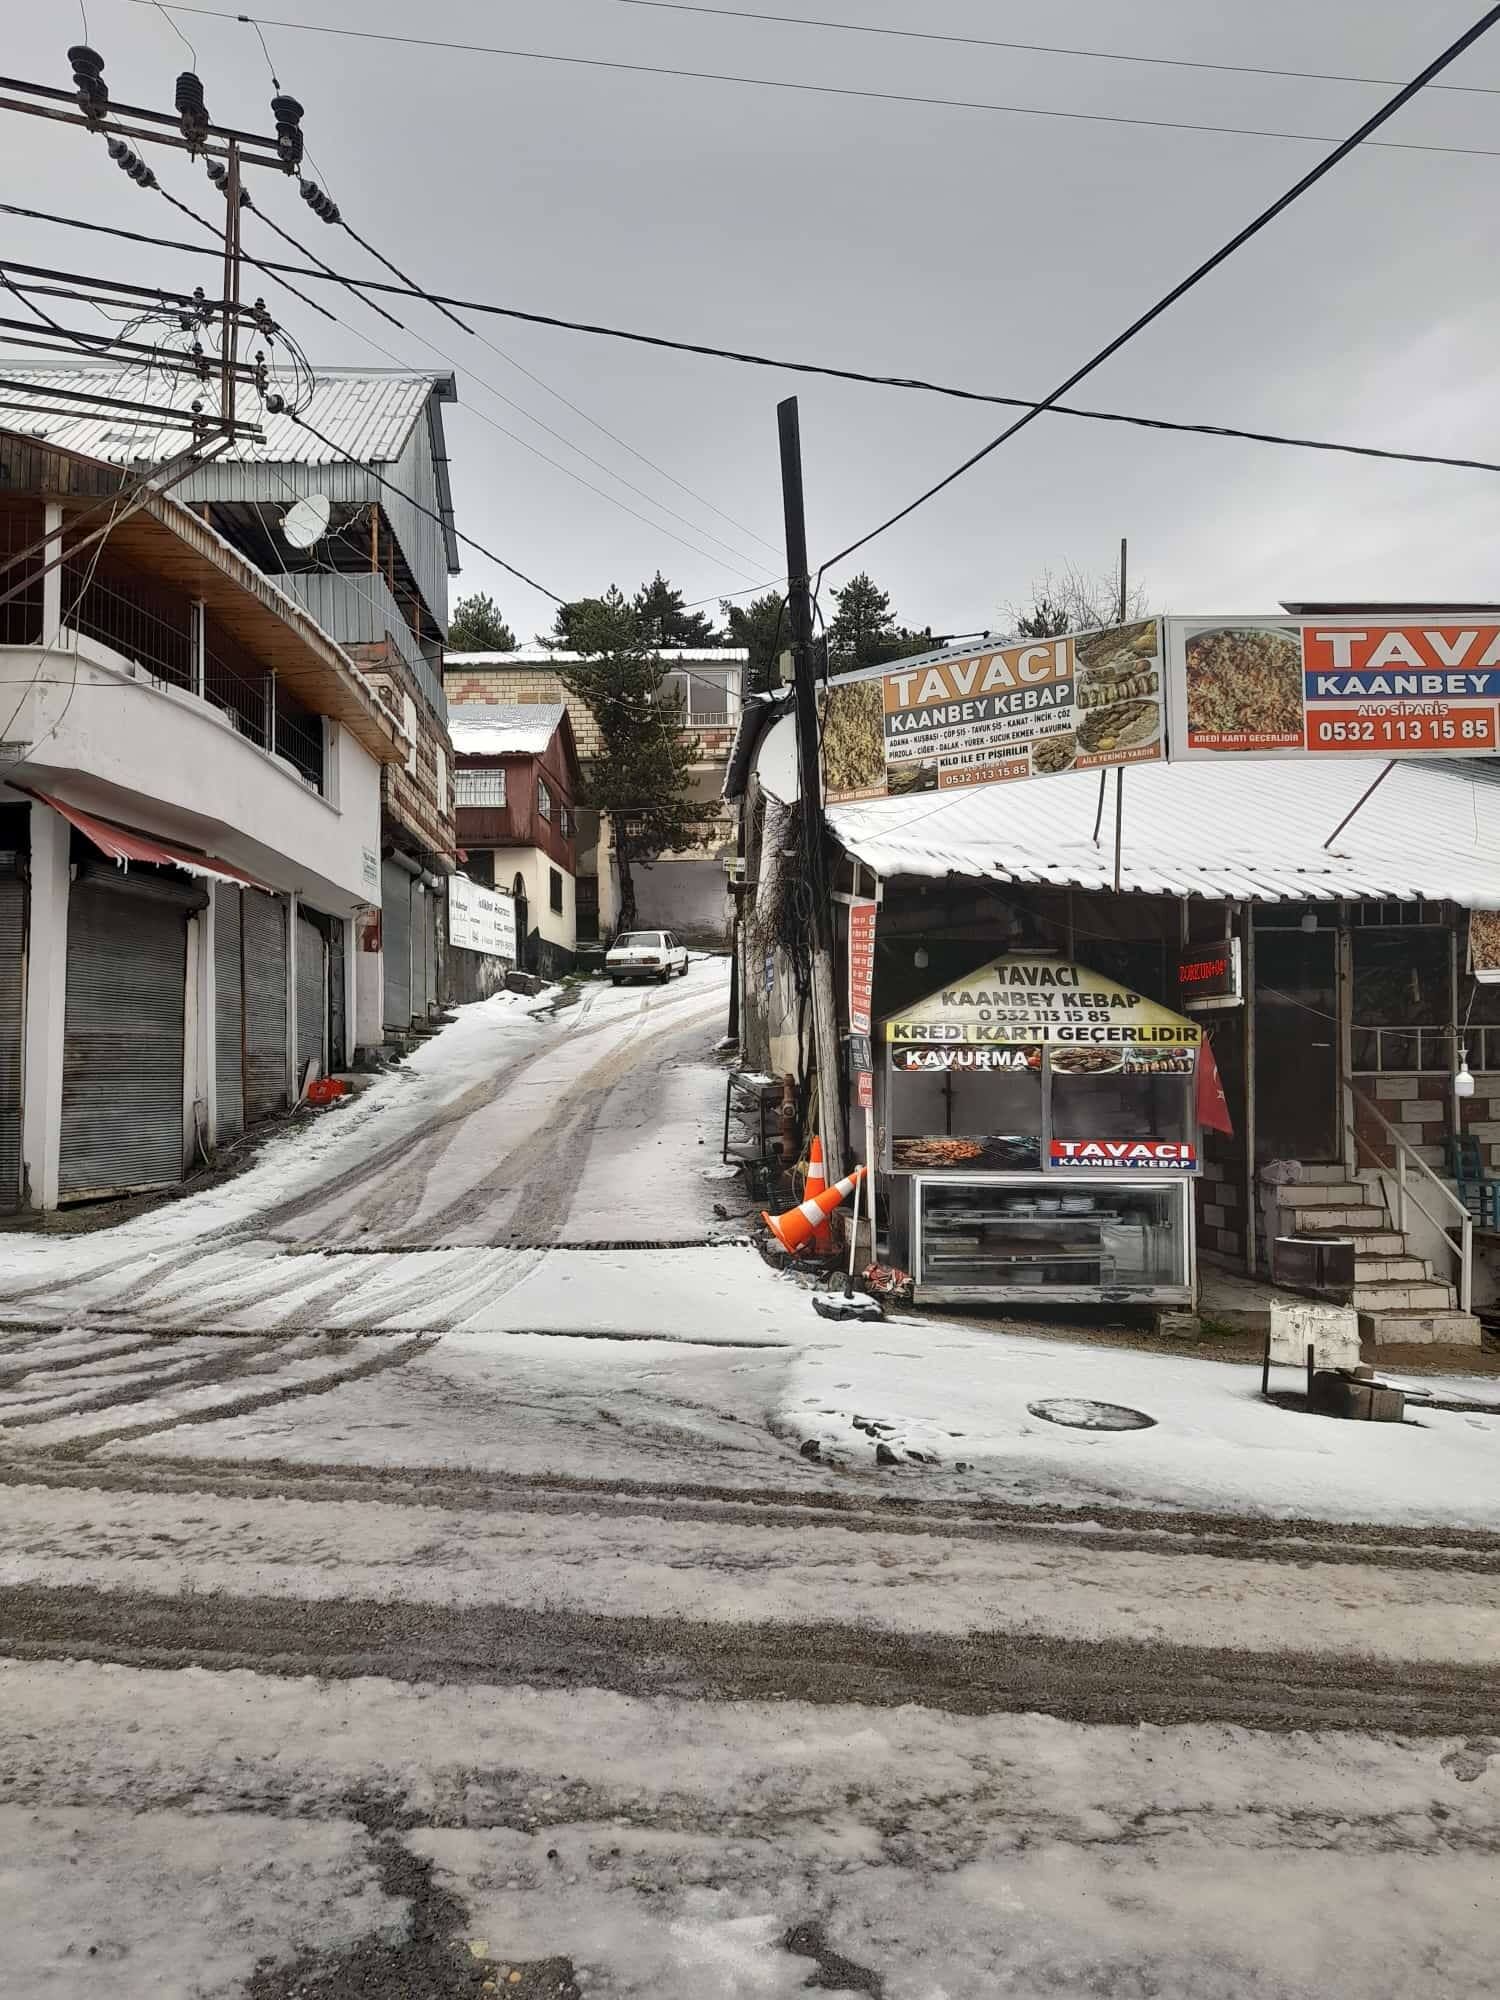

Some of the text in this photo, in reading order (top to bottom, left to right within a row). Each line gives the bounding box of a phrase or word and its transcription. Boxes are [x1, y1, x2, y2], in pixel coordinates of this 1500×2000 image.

[889, 641, 1068, 707] TAVACI
[1317, 674, 1491, 695] KAANBEY
[891, 684, 1070, 733] KAANBEY KEBAP
[1358, 701, 1448, 718] ALO SİPARİŞ
[971, 724, 990, 734] TAVUK
[1007, 718, 1028, 728] KANAT
[990, 733, 1009, 743] SUCUK
[1012, 729, 1034, 739] EKMEK
[1040, 722, 1072, 734] KAVURMA
[1318, 719, 1488, 742] 0532 113 15 85
[1222, 734, 1247, 743] KARTI
[975, 751, 986, 762] ET
[945, 764, 1027, 785] 0532 113 15 85
[994, 966, 1079, 986] TAVACI
[942, 991, 1140, 1008] KAANBEY KEBAP
[996, 1009, 1030, 1021] 532
[1033, 1010, 1060, 1021] 113
[1064, 1010, 1084, 1022] 15
[1087, 1010, 1110, 1022] 85
[976, 1026, 1049, 1041] KARTI
[906, 1051, 1028, 1066] KAVURMA
[1059, 1142, 1189, 1158] TAVACI
[1059, 1158, 1190, 1168] KAANBEY KEBAP
